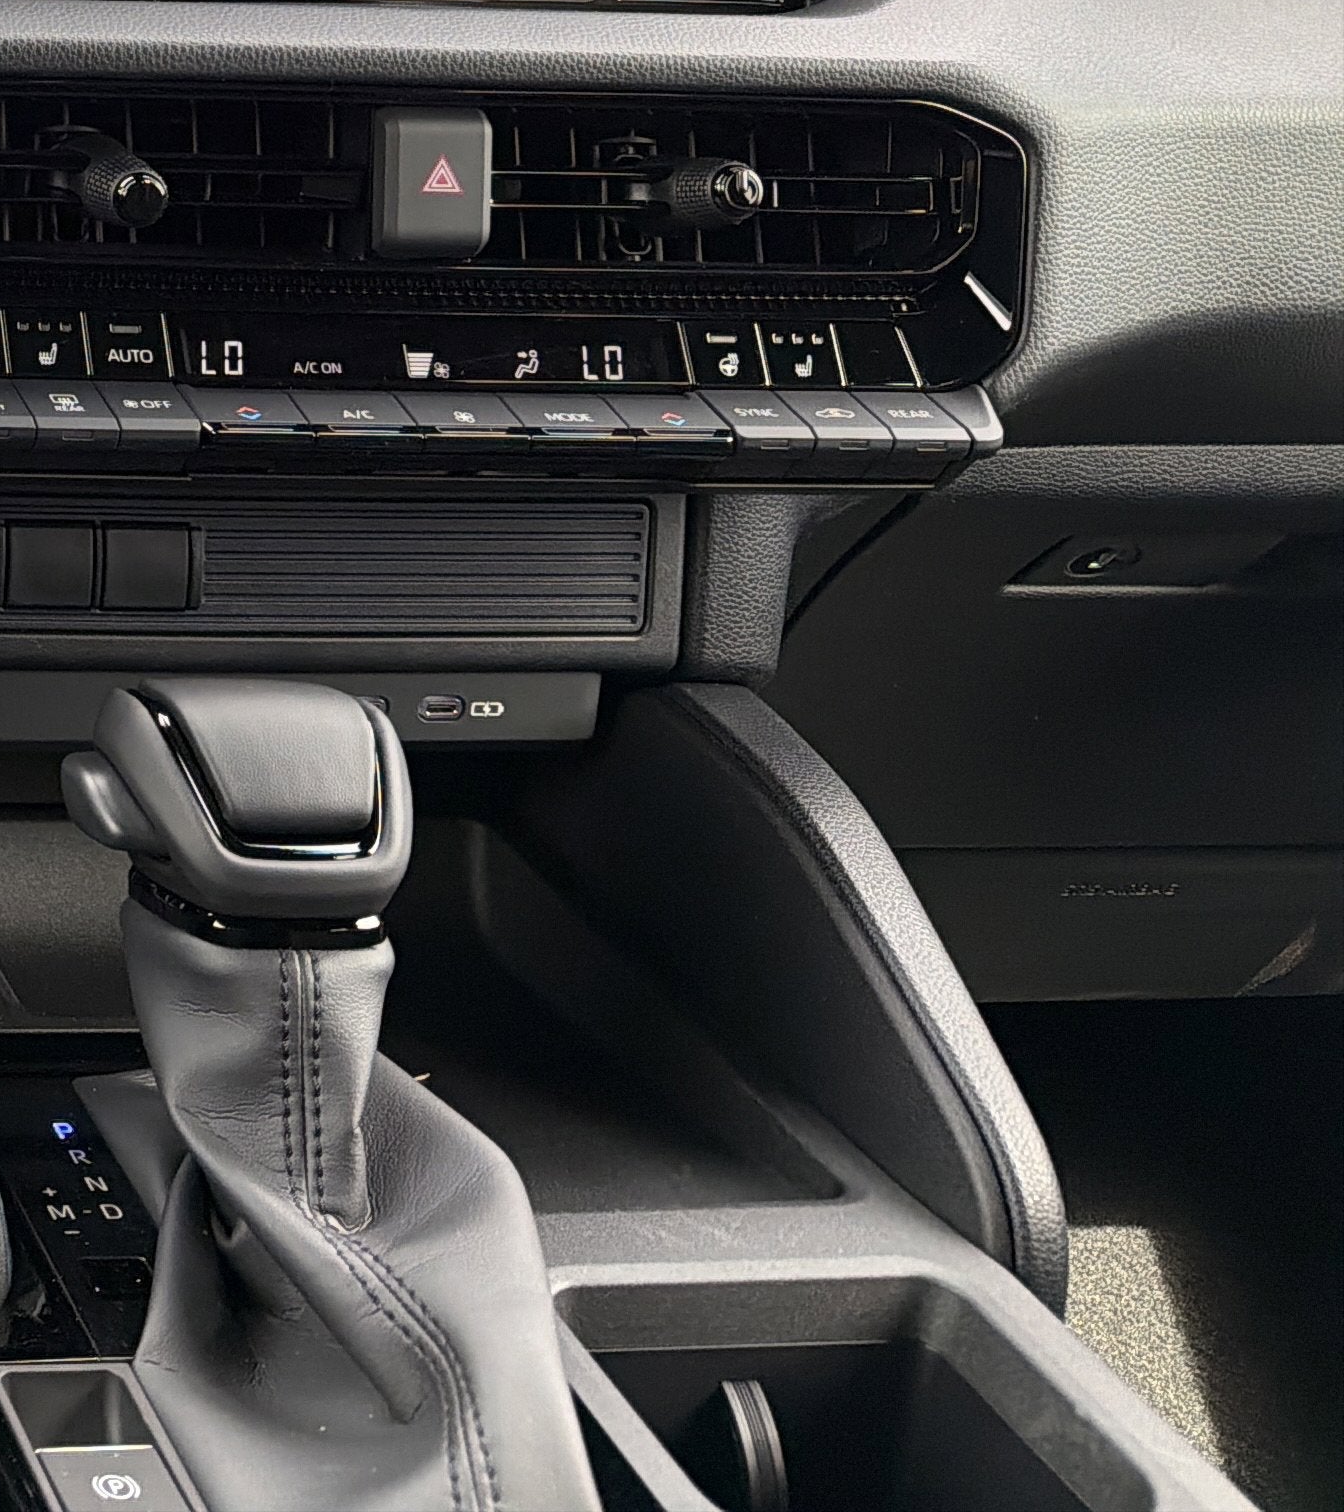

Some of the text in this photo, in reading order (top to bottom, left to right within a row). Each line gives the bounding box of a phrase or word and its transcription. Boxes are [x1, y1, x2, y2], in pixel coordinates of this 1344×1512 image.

[108, 348, 153, 365] AUTO
[293, 361, 342, 375] A/C ON
[54, 403, 85, 412] REAR
[141, 399, 172, 410] OFF
[343, 410, 374, 420] A/C
[544, 412, 594, 423] MODE
[733, 407, 780, 419] SYNC
[888, 408, 934, 419] REAR
[52, 1122, 74, 1140] P
[68, 1149, 93, 1165] R
[84, 1177, 109, 1192] N
[47, 1204, 124, 1220] M D
